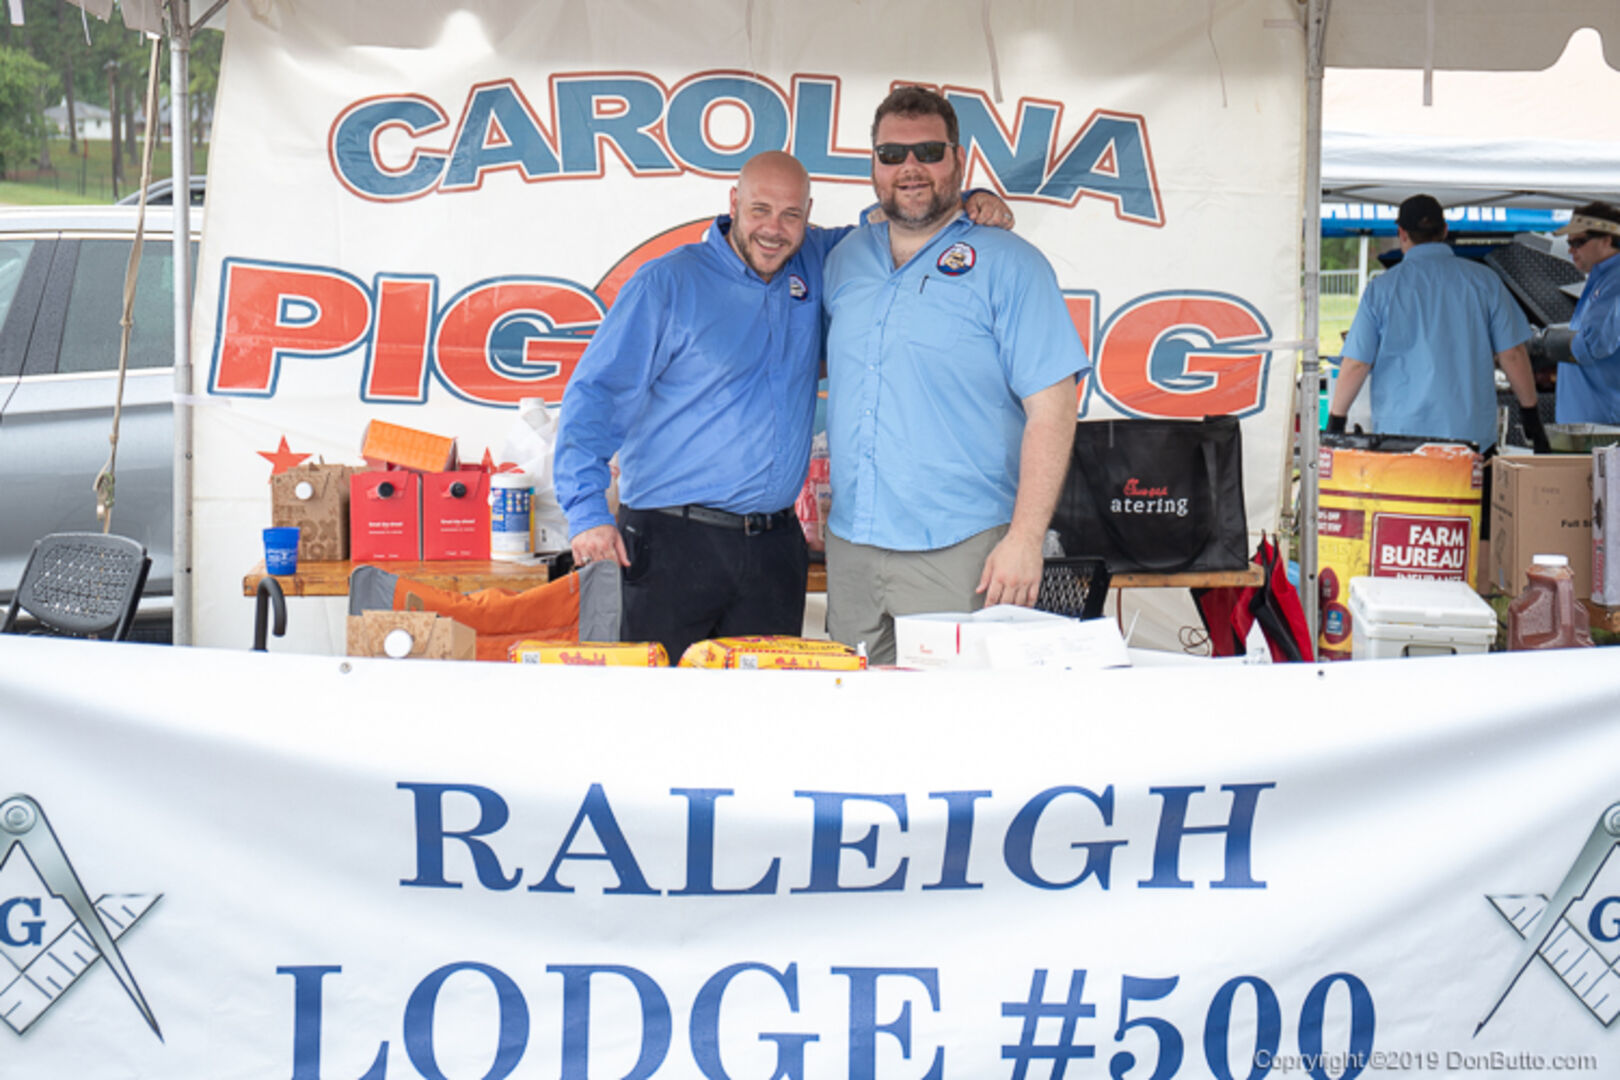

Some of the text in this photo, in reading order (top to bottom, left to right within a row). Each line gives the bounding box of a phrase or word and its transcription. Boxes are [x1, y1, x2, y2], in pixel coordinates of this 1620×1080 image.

[328, 70, 1166, 227] CAROLNA
[208, 257, 608, 409] PIG
[1381, 544, 1465, 569] BUREAU
[1409, 525, 1464, 547] FARM
[397, 781, 1276, 896] RALEIGH
[276, 961, 1376, 1080] LODGE #500
